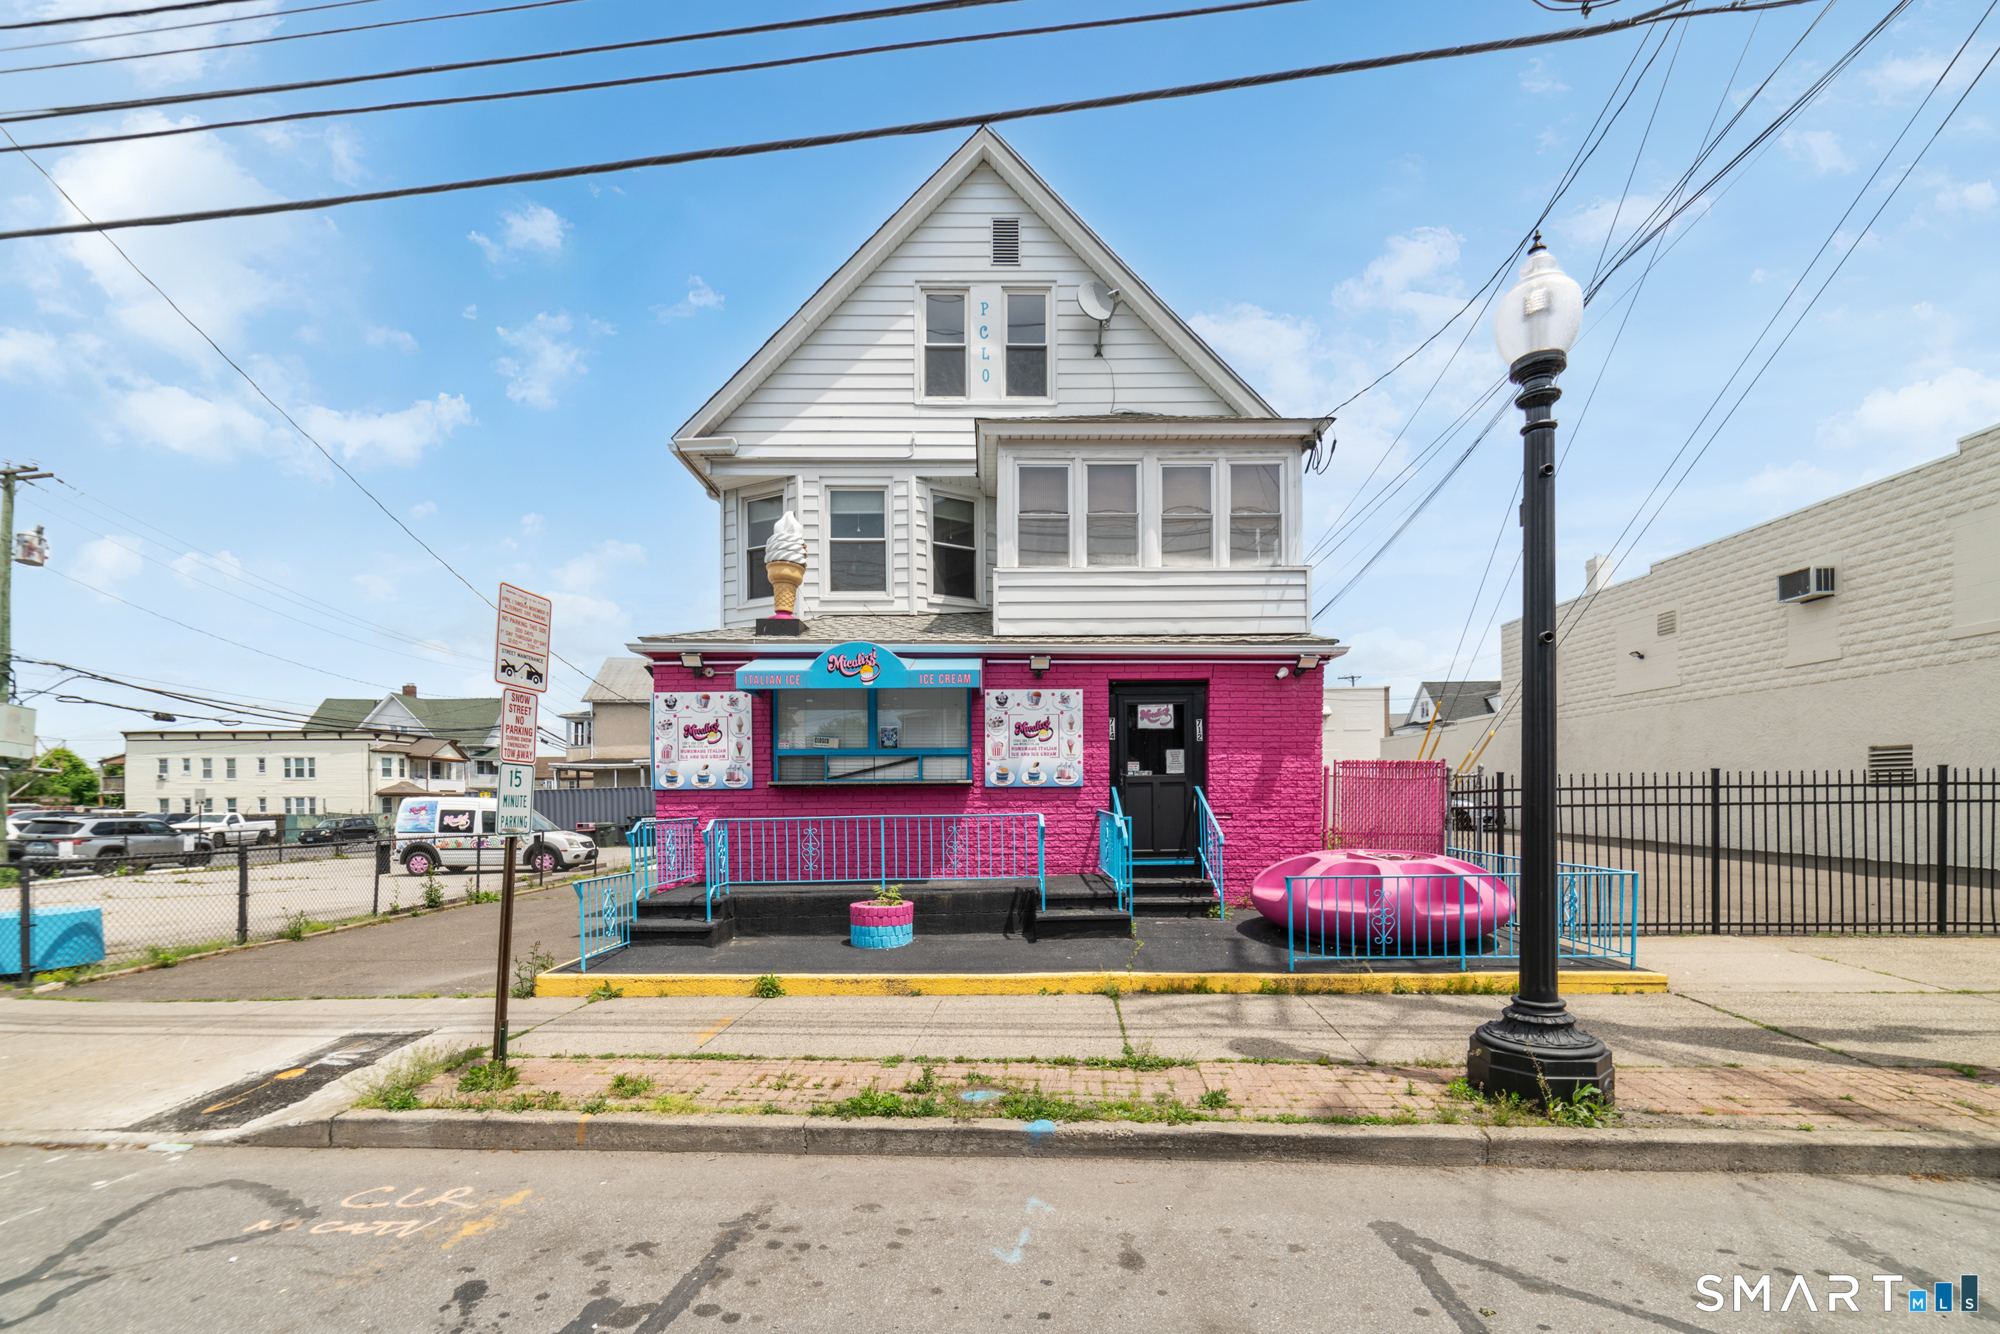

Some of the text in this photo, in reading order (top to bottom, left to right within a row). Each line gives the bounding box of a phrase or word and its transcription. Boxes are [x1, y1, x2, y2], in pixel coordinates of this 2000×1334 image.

[504, 603, 523, 614] ALTERNATE
[532, 613, 546, 622] PARKING
[510, 617, 528, 628] PARKING
[529, 623, 537, 631] THIS
[539, 626, 547, 635] SIDE
[515, 633, 532, 642] THROUGH
[501, 648, 544, 664] STREET MAINTENANCE
[827, 646, 879, 678] Micalizzi
[744, 674, 801, 686] ITALIAN ICE
[919, 673, 971, 685] ICE CREAM
[511, 692, 531, 704] SNOW
[508, 703, 532, 716] STREET
[515, 715, 525, 725] NO
[505, 723, 533, 737] PARKING
[507, 741, 530, 749] EMERGENCY
[504, 748, 533, 760] TOW AWAY
[510, 770, 522, 788] 15
[503, 794, 527, 808] MINUTE
[501, 815, 528, 828] PARKING
